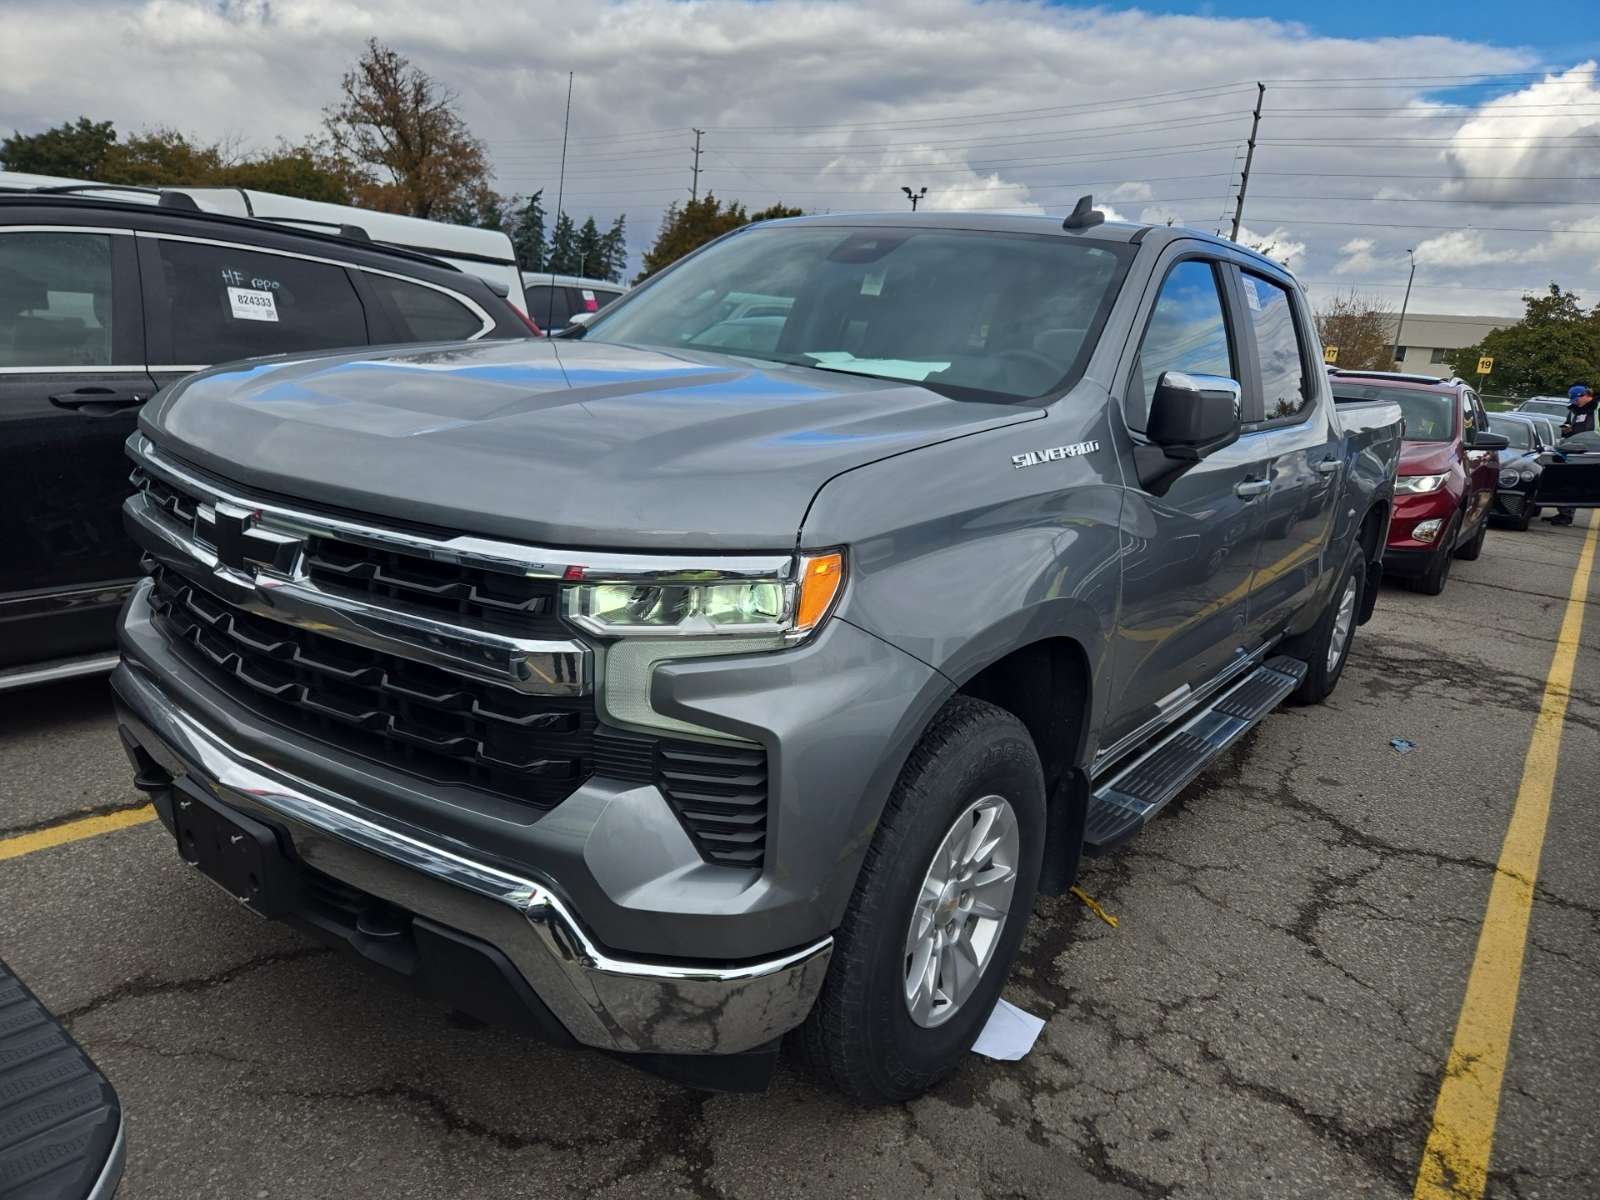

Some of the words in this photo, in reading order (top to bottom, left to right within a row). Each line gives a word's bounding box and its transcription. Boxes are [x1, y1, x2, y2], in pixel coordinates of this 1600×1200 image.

[238, 294, 272, 307] 824333
[1327, 350, 1337, 358] 17
[1480, 360, 1491, 369] 19
[1012, 440, 1100, 468] SILVERADO
